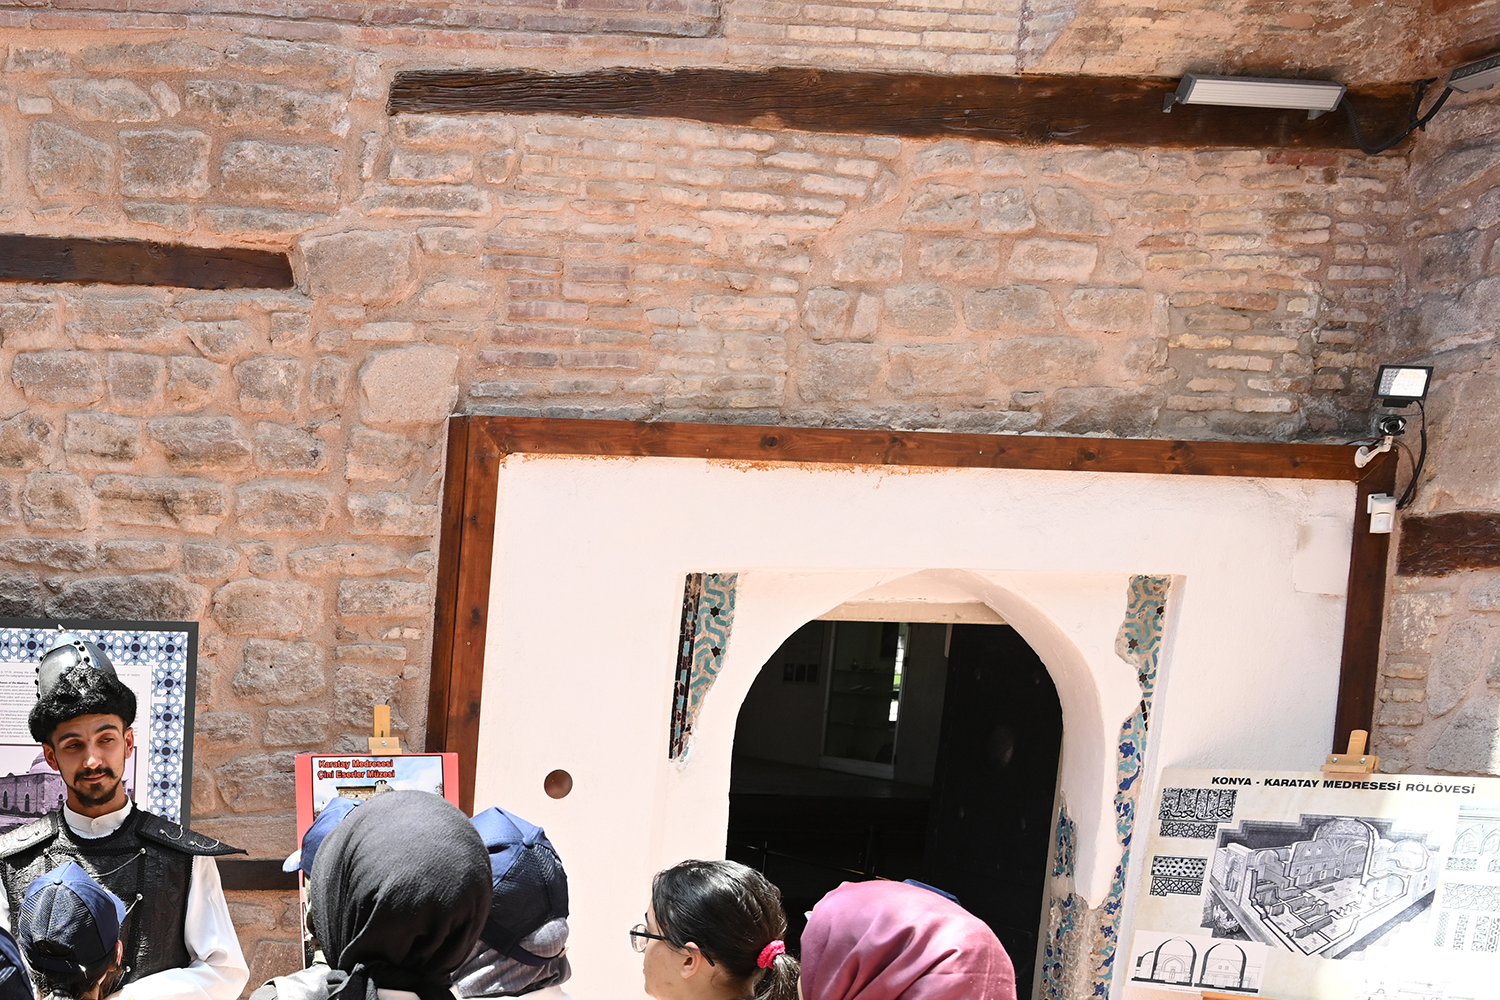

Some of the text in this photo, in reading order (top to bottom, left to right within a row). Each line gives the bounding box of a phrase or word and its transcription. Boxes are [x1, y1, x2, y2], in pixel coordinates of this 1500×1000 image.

[318, 759, 394, 769] Karatay Medresesi
[317, 769, 395, 780] Çini Eserler Müzesi
[1211, 776, 1252, 786] KONYA
[1264, 778, 1320, 788] KARATAY
[1323, 780, 1401, 791] MEDRESESİ
[1405, 781, 1476, 794] RÖLÖVESİ
